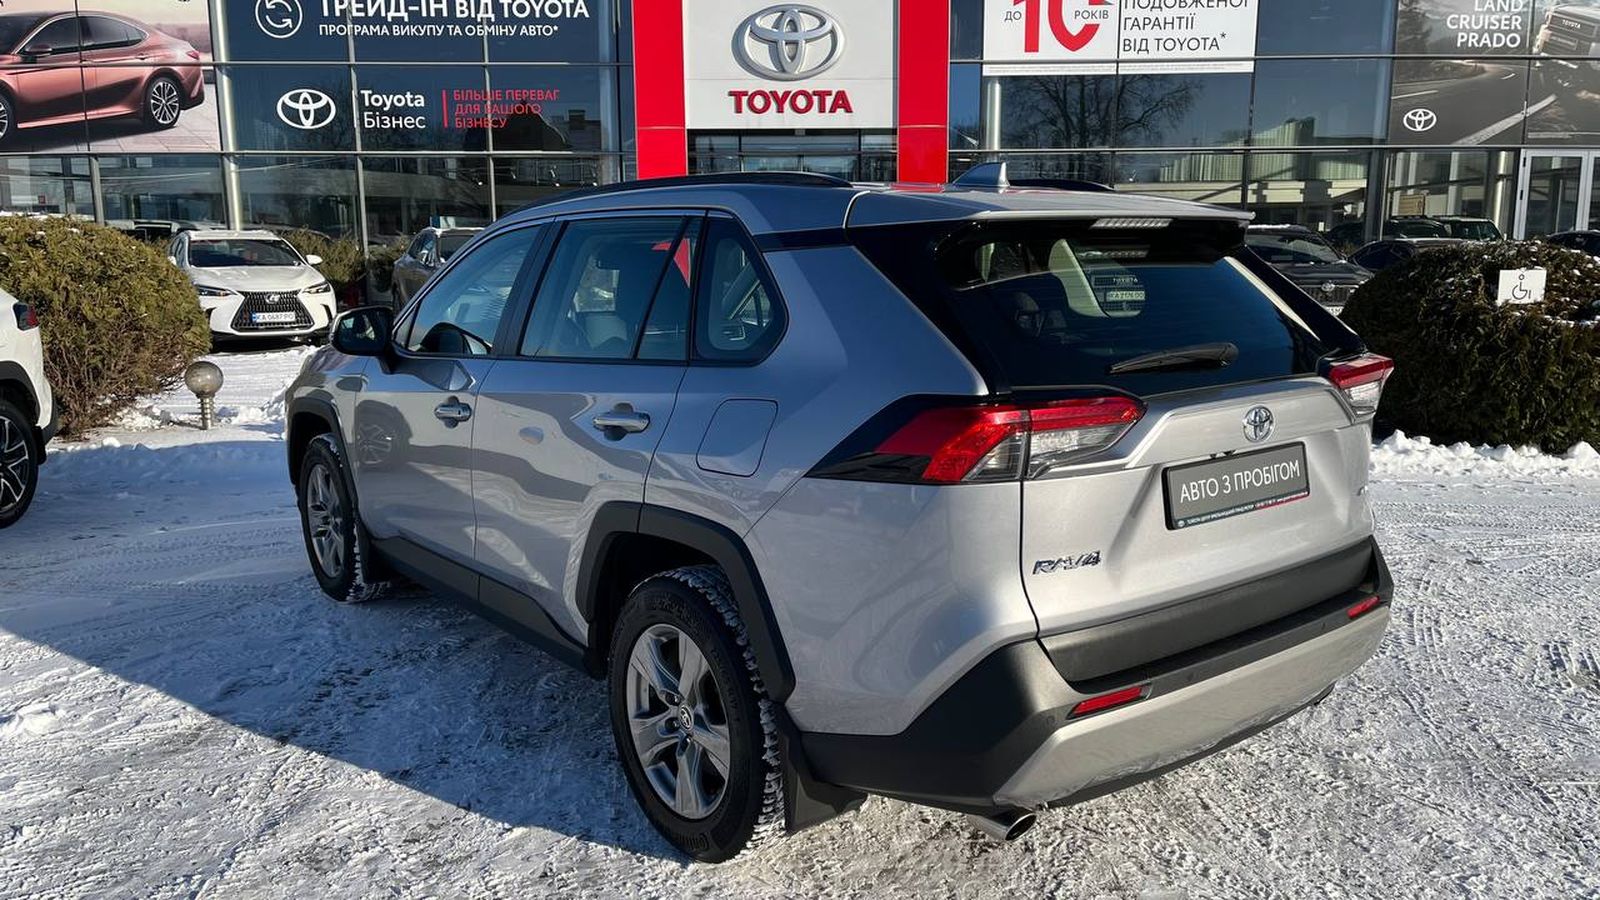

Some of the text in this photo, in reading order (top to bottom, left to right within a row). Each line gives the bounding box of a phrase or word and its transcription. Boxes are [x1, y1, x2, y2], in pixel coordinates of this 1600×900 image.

[454, 0, 495, 21] ВІД
[500, 0, 590, 18] TOYOTA
[1474, 0, 1523, 12] LAND
[1004, 10, 1022, 23] ДО
[1074, 10, 1110, 20] РОКІВ
[1123, 13, 1195, 31] ГАРАНТІЇ
[1446, 14, 1522, 30] CRUISER
[319, 24, 390, 36] ПРОГРАМА
[392, 25, 444, 37] ВИКУПУ
[446, 25, 463, 36] ТА
[465, 25, 517, 37] ОБМІНУ
[1123, 38, 1150, 54] ВІД
[1456, 32, 1521, 48] PRADO
[361, 90, 425, 110] Toyota
[453, 89, 560, 101] БІЛЬШЕ ПЕРЕВАГ
[728, 89, 853, 114] TOYOTA
[454, 103, 543, 116] ДЛЯ ВАШОГО
[363, 111, 426, 129] Бізнес
[455, 117, 507, 129] БІЗНЕСУ
[1180, 478, 1219, 503] АВТО
[1233, 459, 1301, 490] ПРОБІГОМ
[1032, 550, 1101, 575] RAV4
